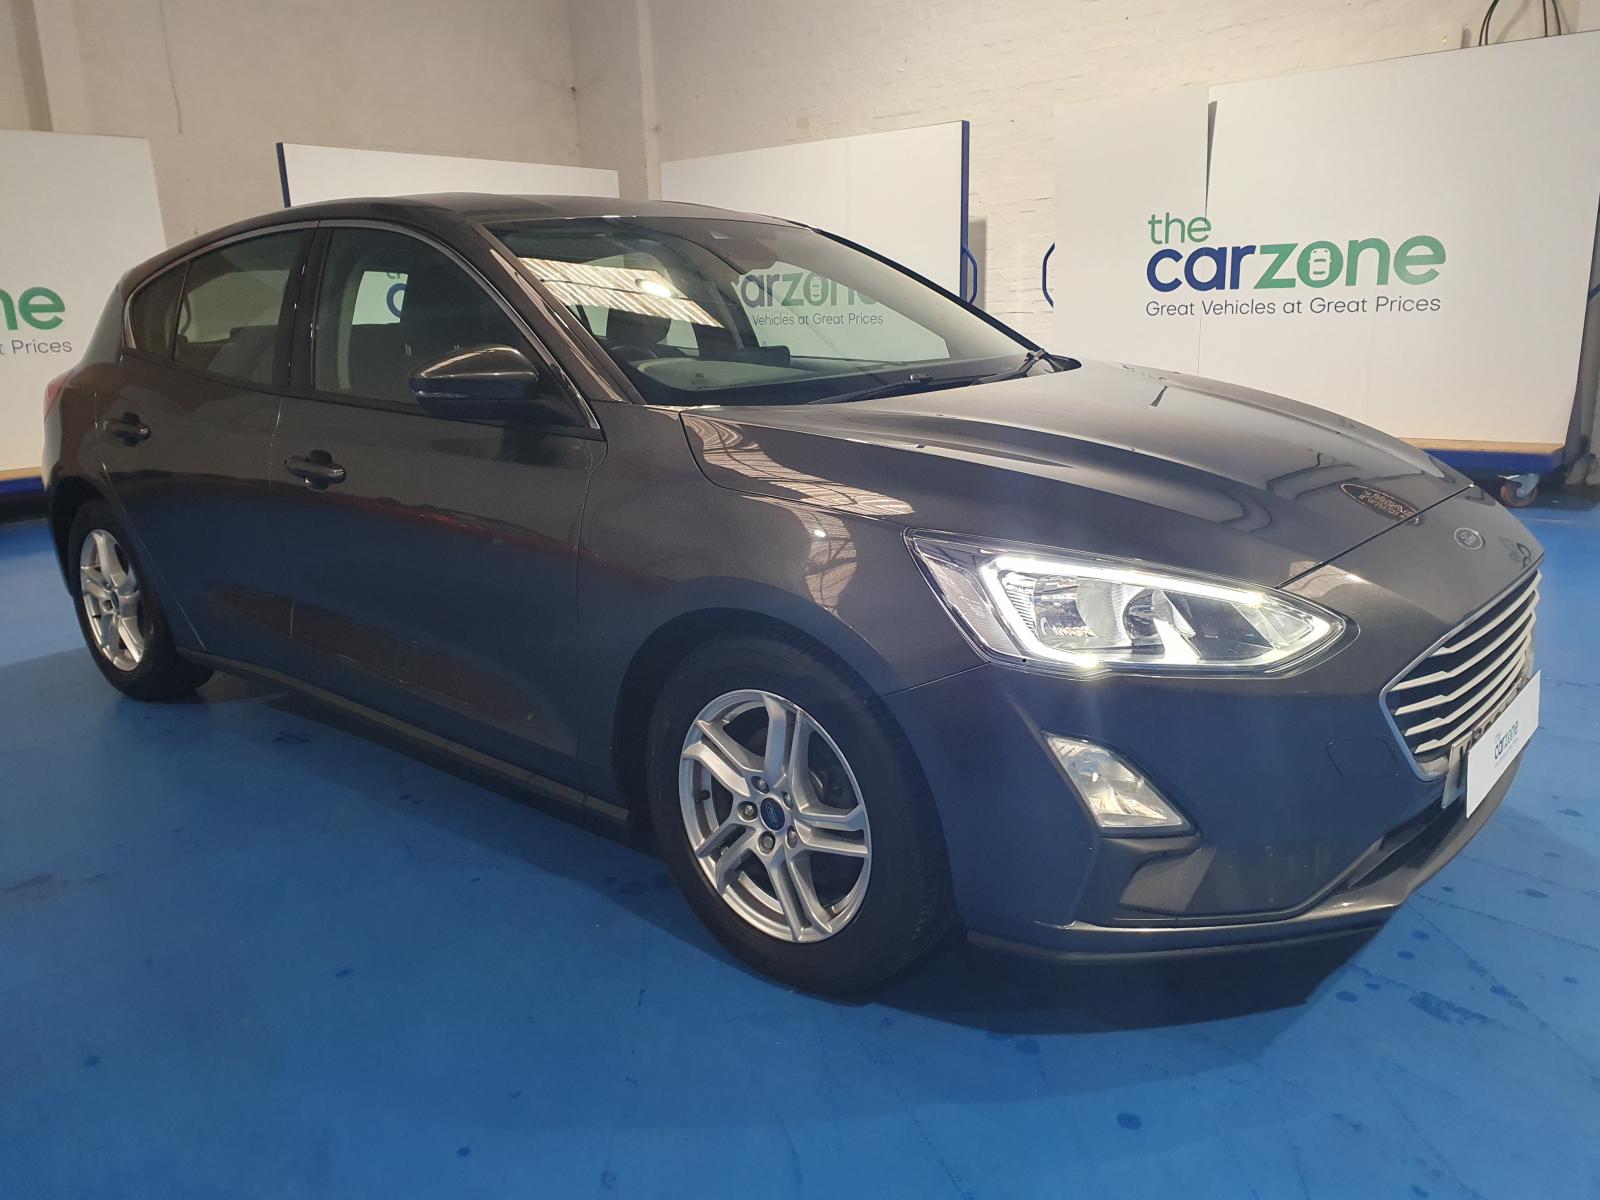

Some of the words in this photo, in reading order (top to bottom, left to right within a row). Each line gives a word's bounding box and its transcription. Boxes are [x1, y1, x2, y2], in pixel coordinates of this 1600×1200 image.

[1147, 212, 1212, 244] the
[1146, 235, 1446, 293] carzone
[1146, 300, 1195, 317] Great
[1202, 298, 1276, 316] Vehicles
[1283, 298, 1302, 315] at
[1310, 297, 1367, 314] Great
[1375, 295, 1441, 313] Prices
[752, 313, 795, 326] Vehicles
[797, 313, 809, 326] at
[812, 312, 844, 326] Great
[848, 312, 884, 326] Prices
[11, 339, 73, 354] Prices
